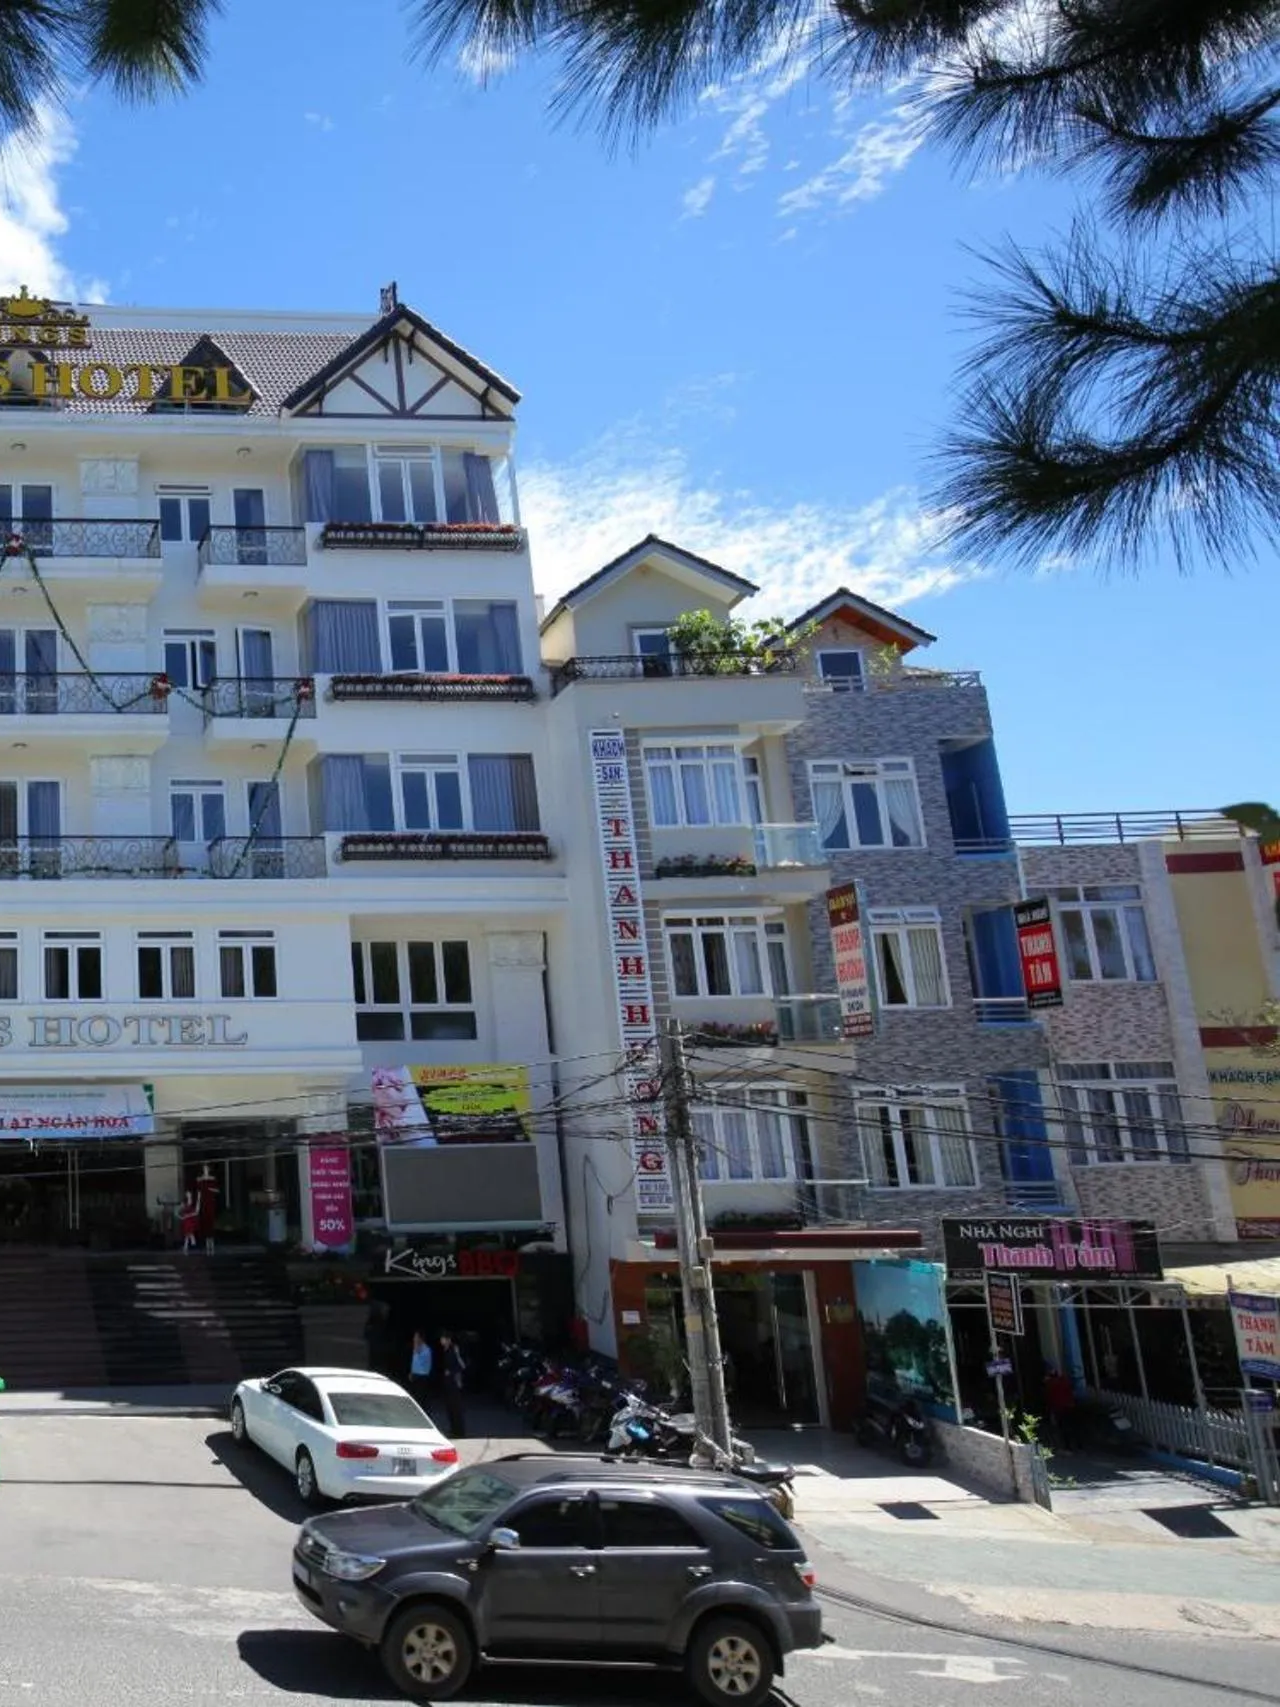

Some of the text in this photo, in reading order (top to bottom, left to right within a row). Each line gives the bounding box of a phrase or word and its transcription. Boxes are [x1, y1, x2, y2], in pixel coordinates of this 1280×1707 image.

[27, 360, 254, 402] HOTEL
[27, 1013, 249, 1048] HOTEL
[319, 1218, 345, 1231] 50%
[959, 1221, 997, 1239] NHÀ
[385, 1248, 457, 1278] Kings
[978, 1239, 1117, 1270] Thanh Tâm
[1237, 1312, 1277, 1334] THANH
